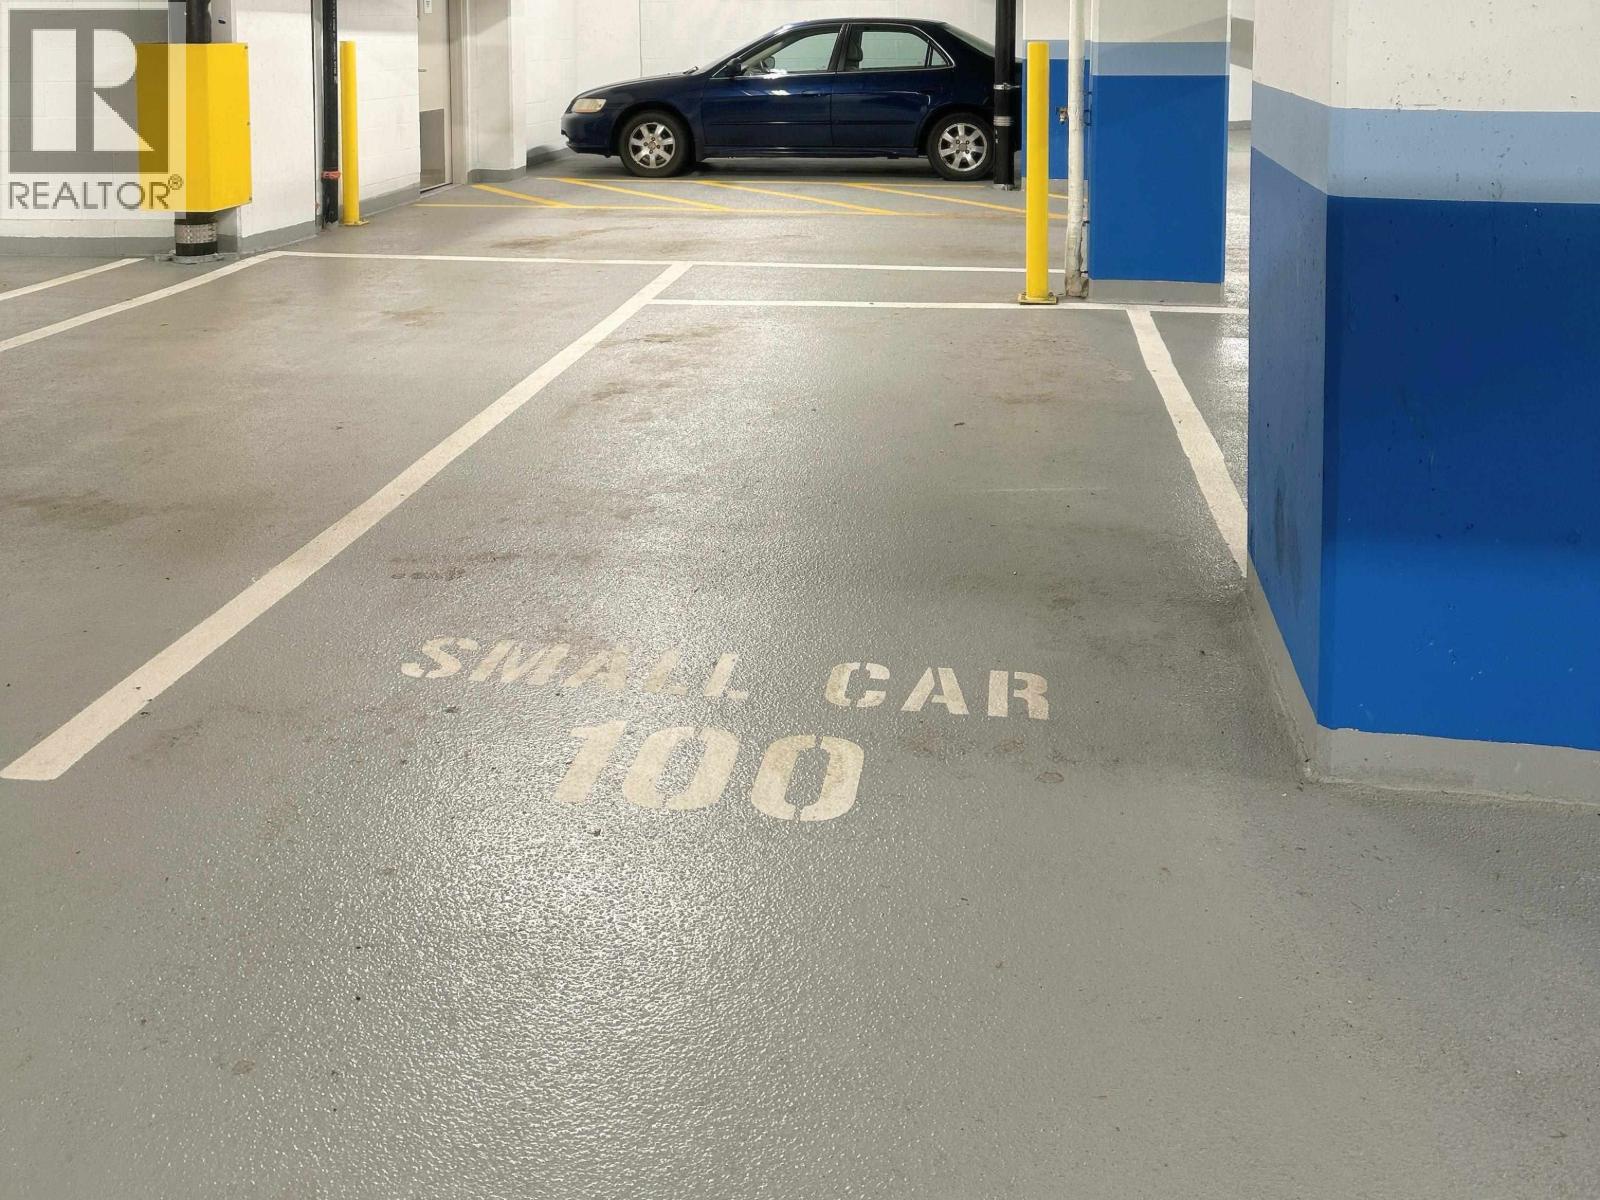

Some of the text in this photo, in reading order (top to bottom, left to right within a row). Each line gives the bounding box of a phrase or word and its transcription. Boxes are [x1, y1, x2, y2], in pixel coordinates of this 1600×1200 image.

[401, 637, 1050, 720] SMALL CAR
[553, 720, 865, 822] 100
